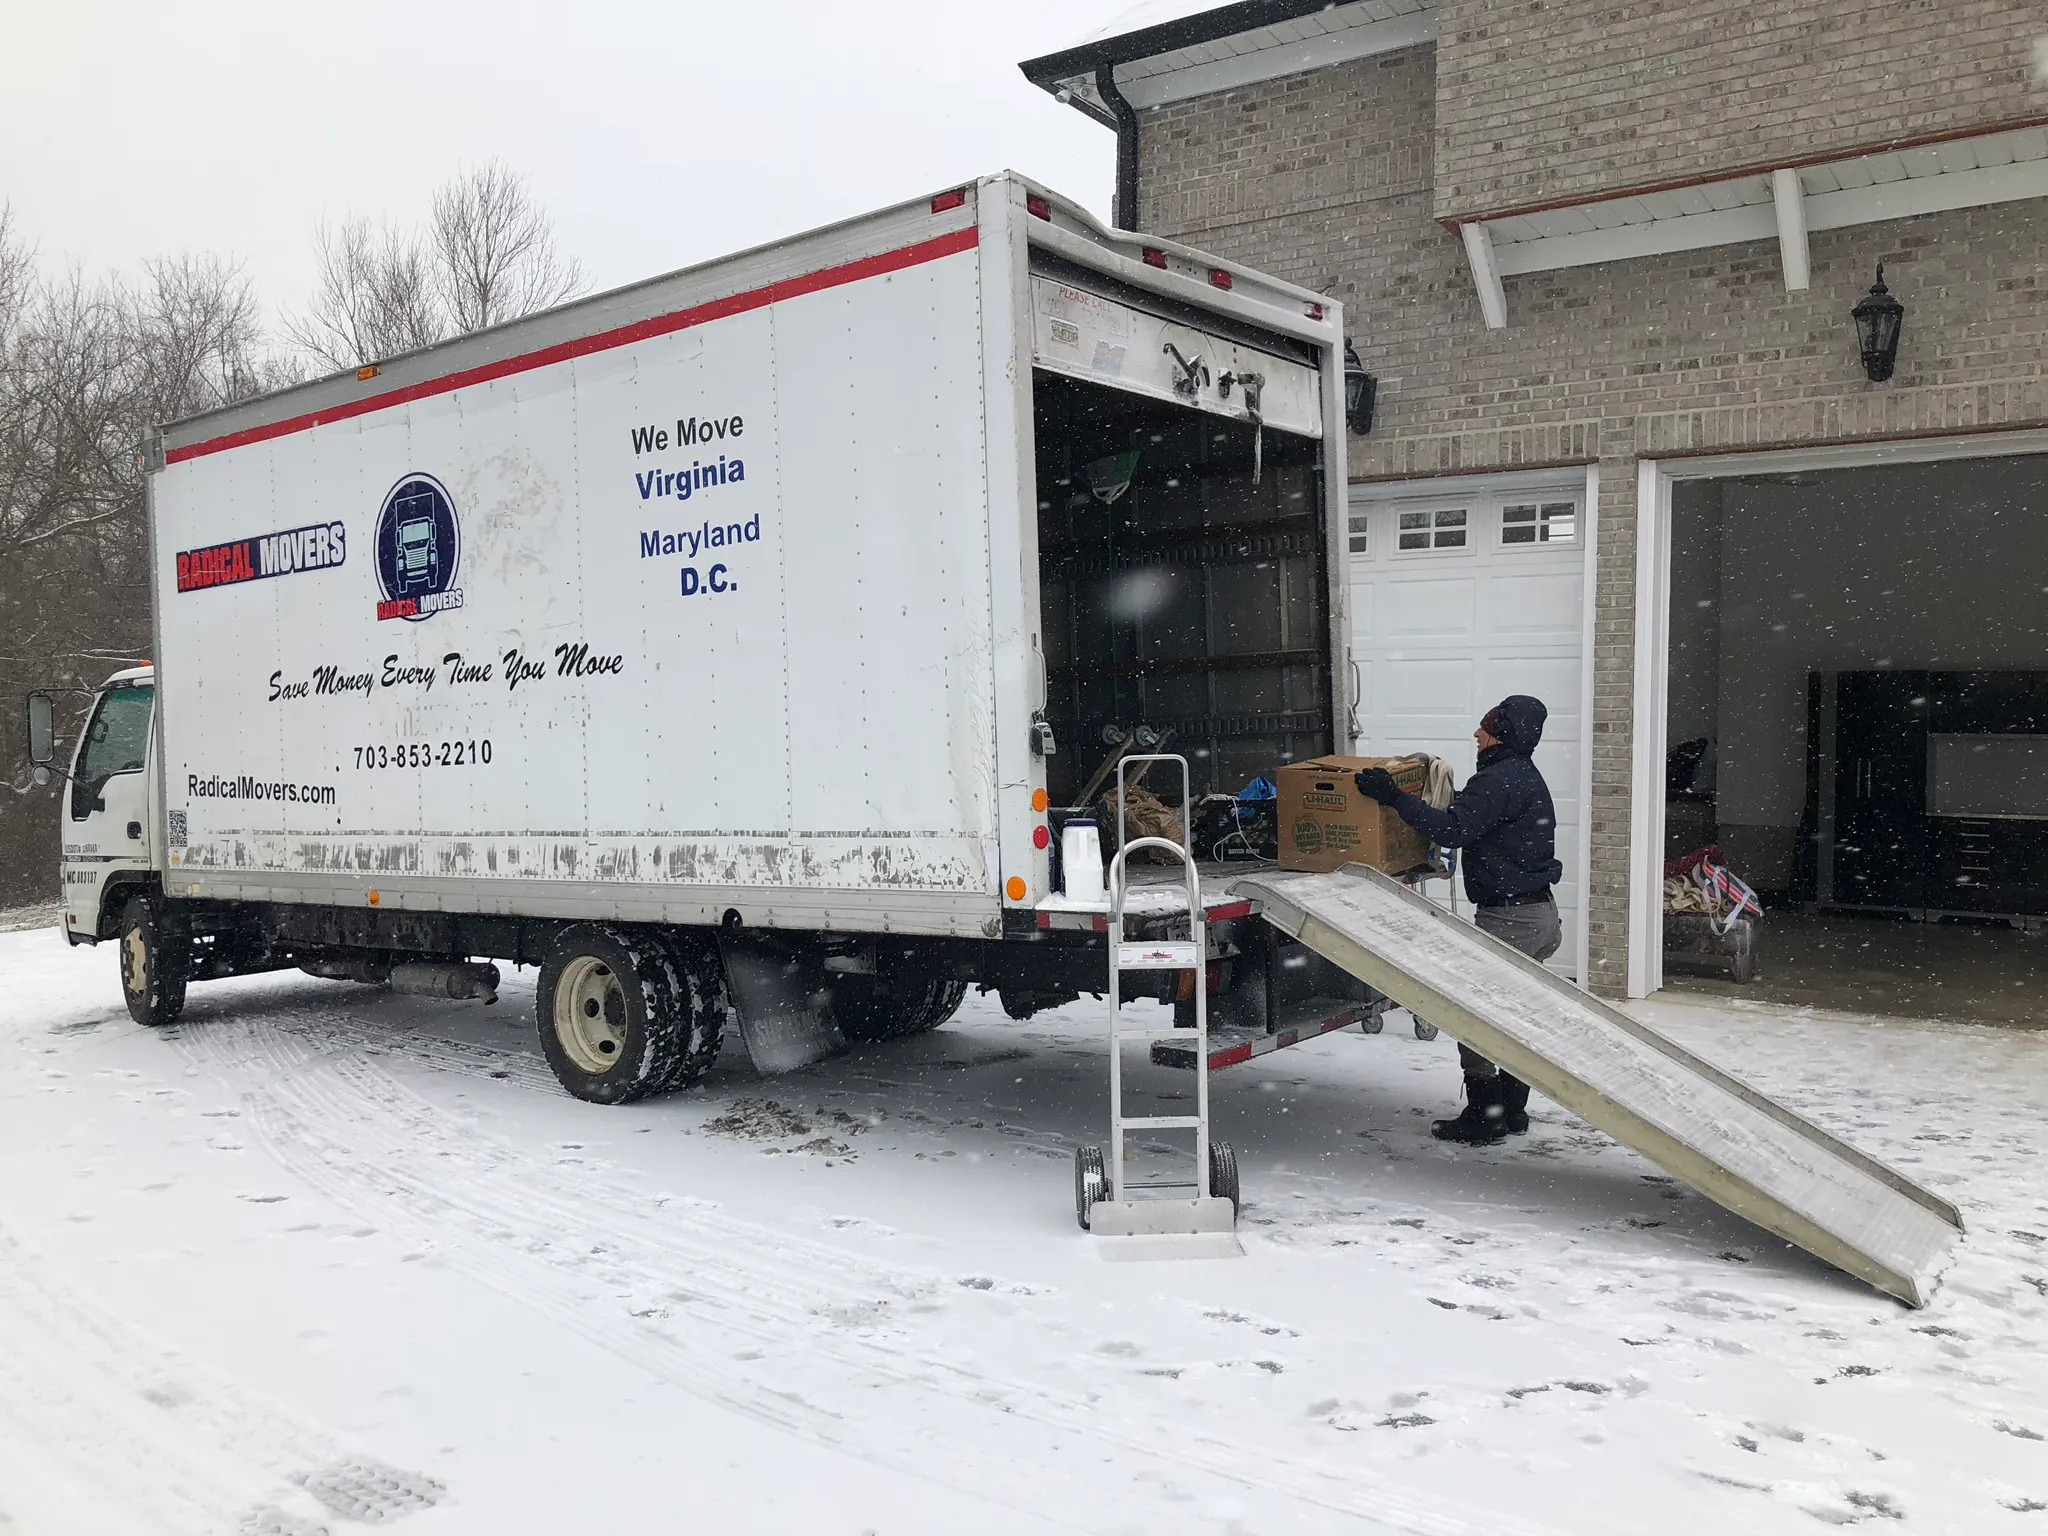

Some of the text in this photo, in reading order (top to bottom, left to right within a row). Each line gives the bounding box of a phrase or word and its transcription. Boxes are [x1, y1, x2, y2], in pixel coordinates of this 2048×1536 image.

[1058, 286, 1089, 305] PLEASE
[631, 415, 744, 455] We Move
[635, 455, 745, 501] Virginia
[640, 513, 760, 558] Maryland
[177, 523, 346, 590] RADICAL MOVERS
[681, 563, 738, 596] D.C.
[377, 588, 463, 620] RADICAL MOVERS
[268, 642, 624, 702] Save Money Every Time You Move
[353, 739, 493, 770] 703-853-2210
[187, 774, 336, 805] RadicalMovers.com
[1305, 794, 1344, 805] U-HAUL
[66, 871, 76, 884] MC
